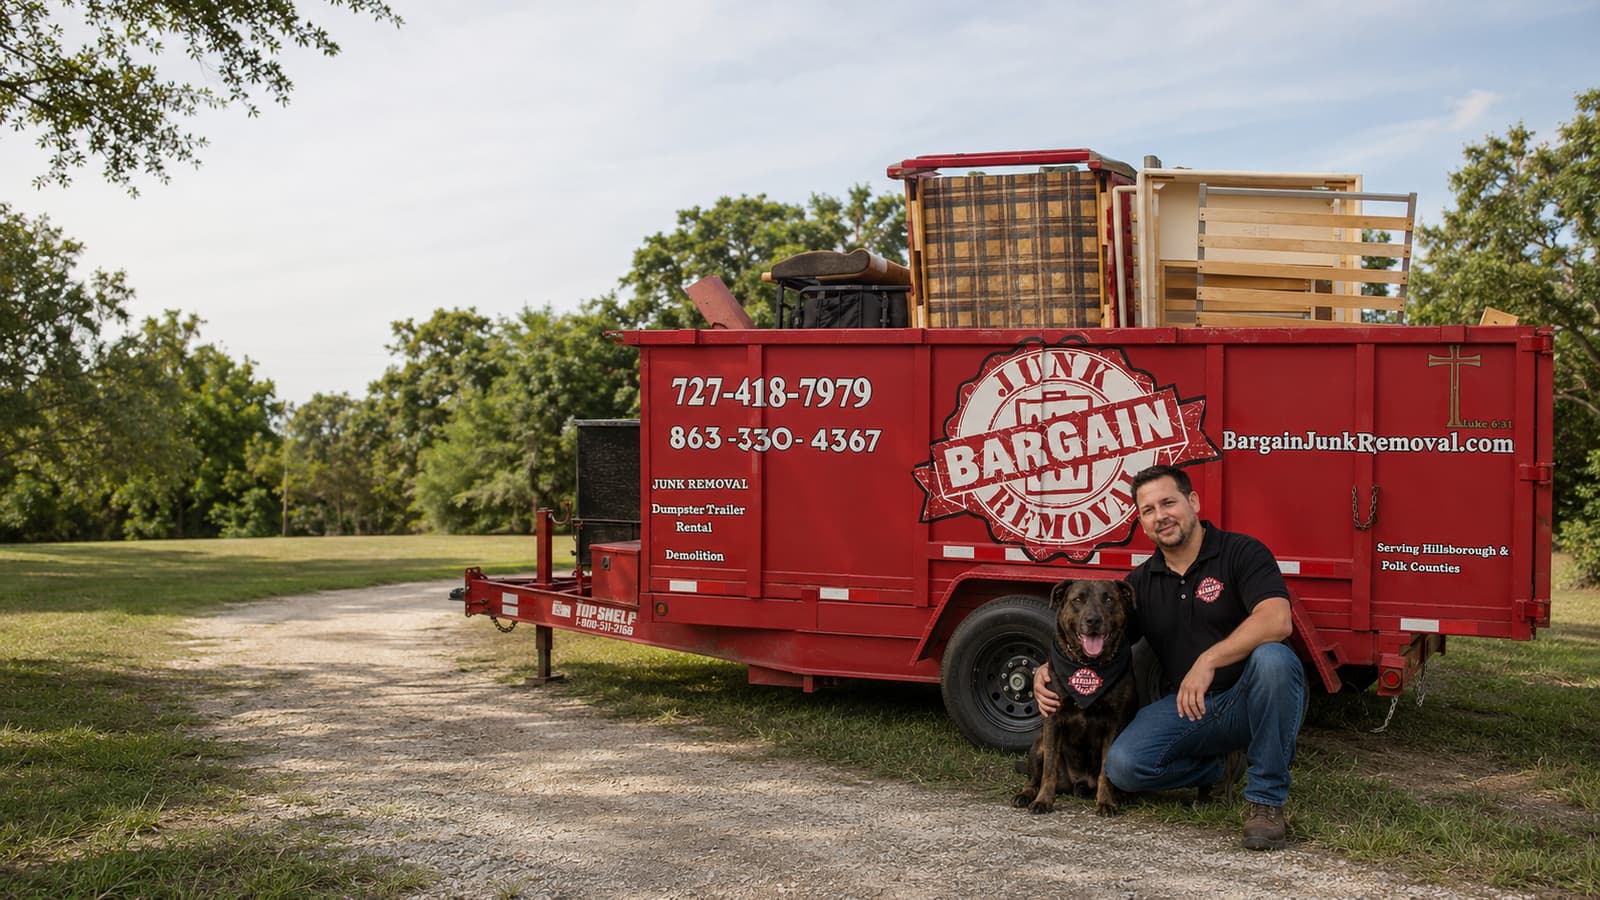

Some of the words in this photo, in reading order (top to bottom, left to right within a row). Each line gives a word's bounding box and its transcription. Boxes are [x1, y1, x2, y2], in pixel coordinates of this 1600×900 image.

[997, 352, 1114, 397] JUNK
[671, 376, 873, 408] 727-418-7979
[1463, 419, 1488, 428] Luke
[943, 399, 1174, 488] BARGAIN
[1222, 431, 1514, 455] BargainJunkRemoval.com
[652, 479, 685, 489] JUNK
[687, 479, 748, 489] REMOVAL
[651, 504, 705, 516] Dumpster
[705, 504, 745, 515] Trailer
[675, 521, 712, 532] Rental
[665, 549, 724, 561] Demolition
[1377, 543, 1419, 555] Serving
[1422, 544, 1496, 557] Hillsborough
[1499, 546, 1509, 555] &
[1381, 561, 1407, 571] Polk
[1410, 562, 1460, 573] Counties
[576, 603, 597, 618] TOP
